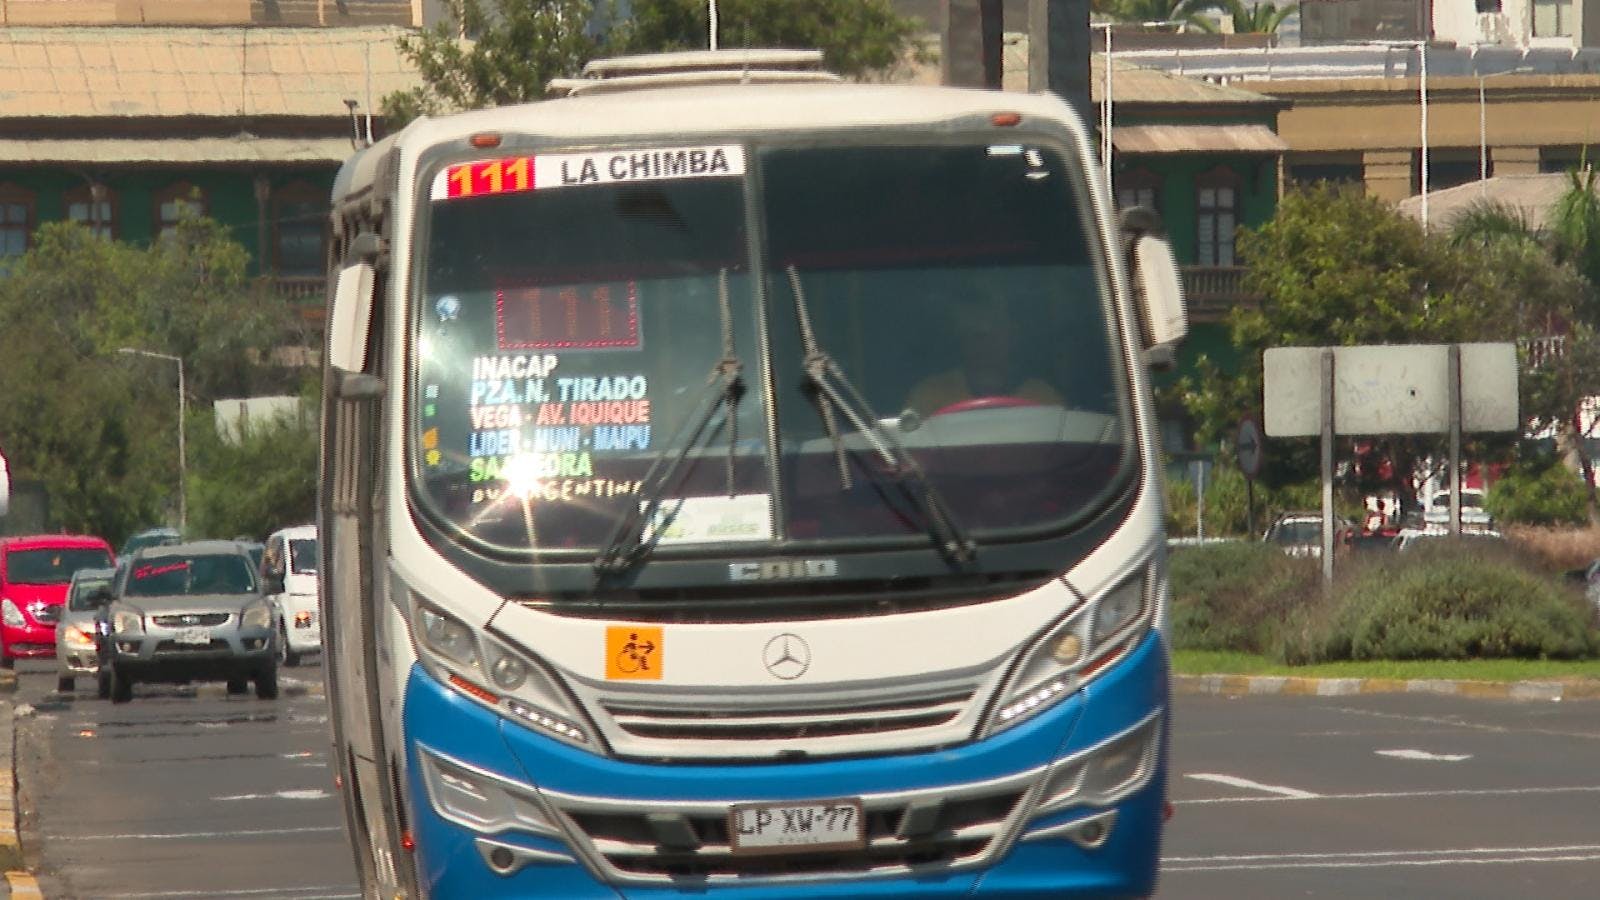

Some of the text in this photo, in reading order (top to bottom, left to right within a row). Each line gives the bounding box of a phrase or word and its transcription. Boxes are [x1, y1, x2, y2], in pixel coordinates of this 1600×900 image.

[450, 156, 528, 196] 111
[561, 148, 730, 185] LA CHIMBA
[522, 286, 611, 339] 111
[472, 354, 558, 380] INACAP
[556, 375, 648, 402] TIRADO
[470, 404, 521, 430] VEGA
[535, 402, 566, 426] AV.
[569, 400, 651, 425] IQUIQUE
[535, 426, 580, 452] MUNI
[593, 424, 651, 450] MAIPU
